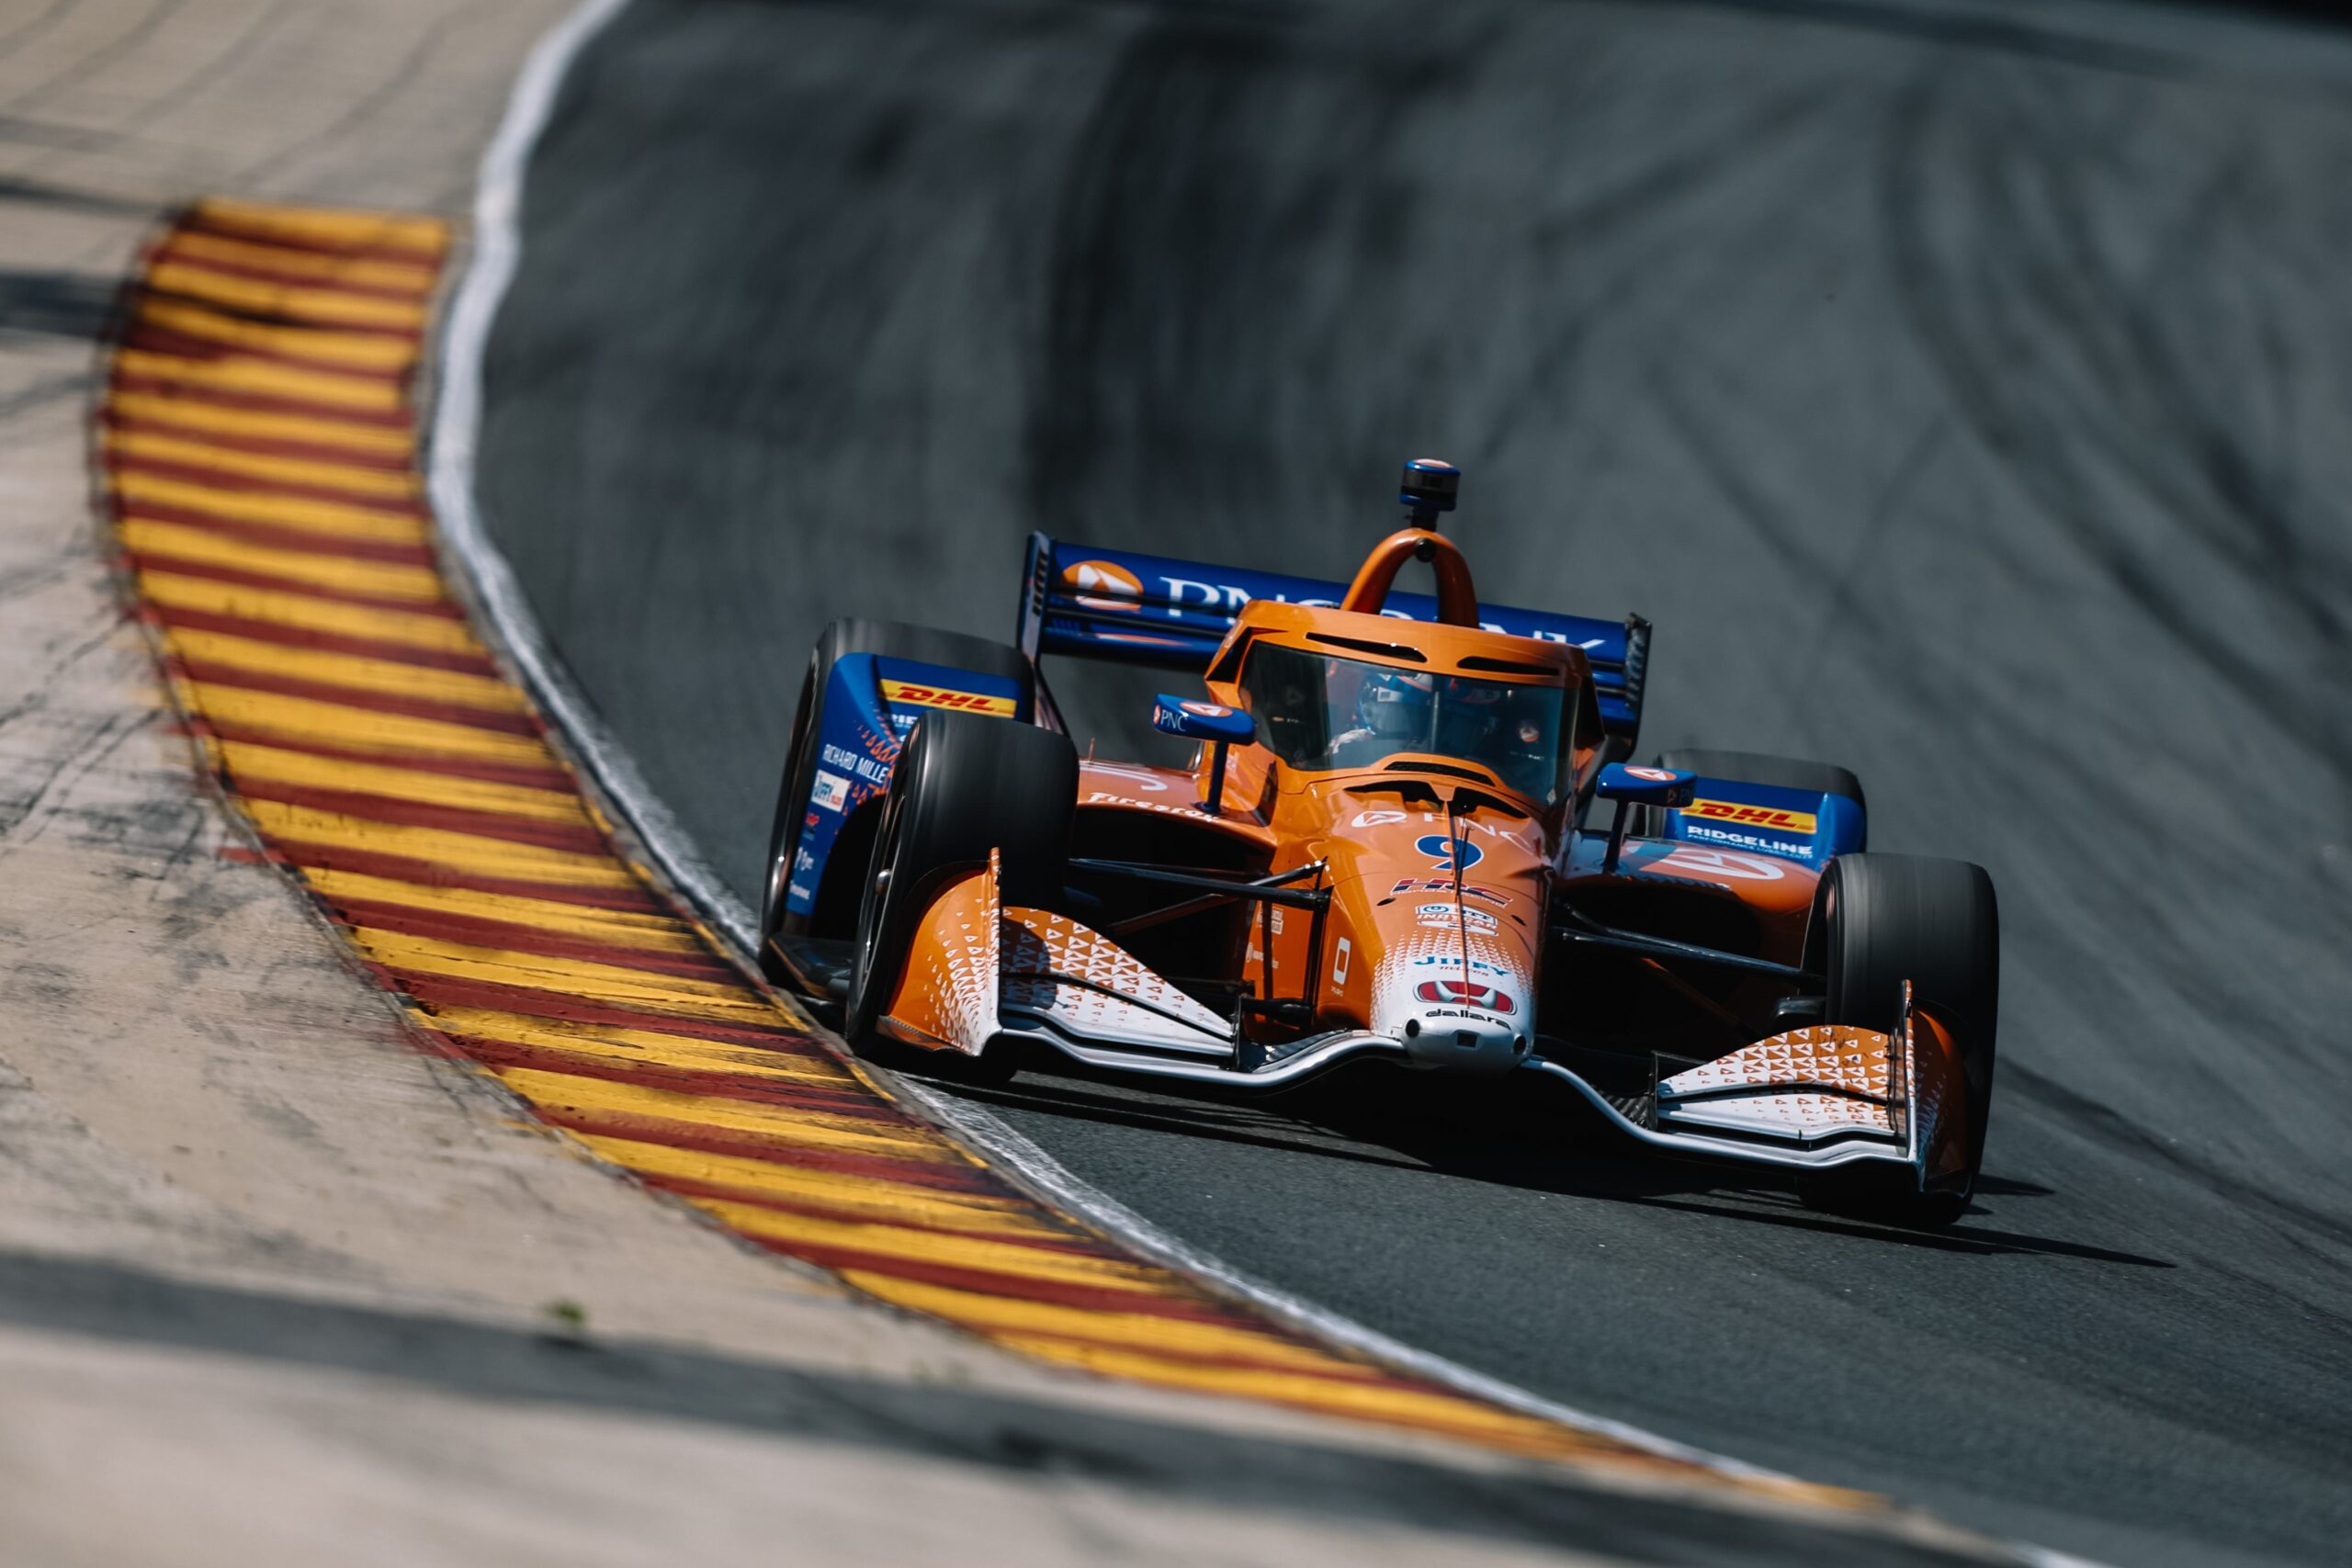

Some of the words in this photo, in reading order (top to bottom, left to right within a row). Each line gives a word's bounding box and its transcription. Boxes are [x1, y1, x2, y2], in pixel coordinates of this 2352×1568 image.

[897, 685, 995, 712] DHL
[1160, 709, 1188, 732] PNC
[822, 743, 858, 771] RICHARD
[855, 757, 890, 784] MILLE
[1698, 802, 1799, 828] DHL
[1414, 834, 1485, 872] 9
[1688, 826, 1814, 855] RIDGELINE
[1426, 1009, 1512, 1031] dallara
